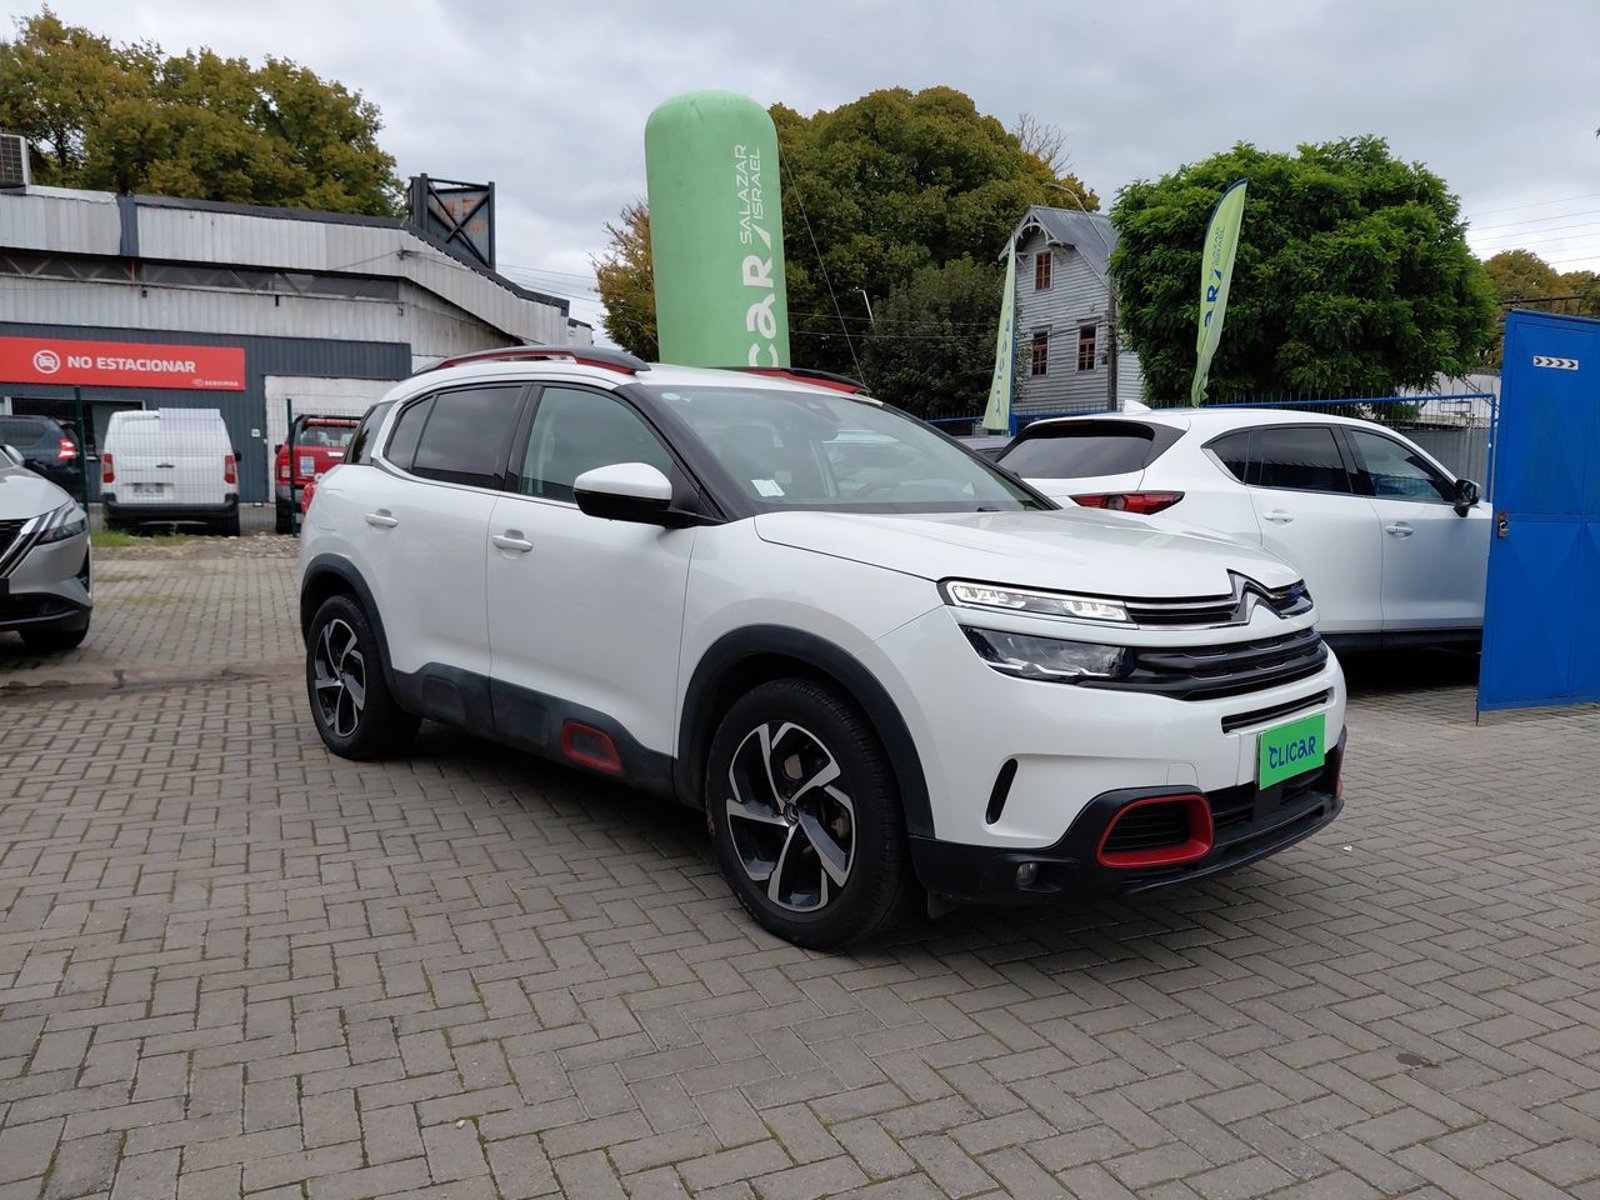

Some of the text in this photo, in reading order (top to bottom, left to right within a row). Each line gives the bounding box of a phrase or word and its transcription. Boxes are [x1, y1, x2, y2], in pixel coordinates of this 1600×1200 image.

[734, 144, 753, 244] SALAZAR
[749, 147, 764, 219] ISRAEL
[66, 355, 197, 374] NO ESTACIONAR
